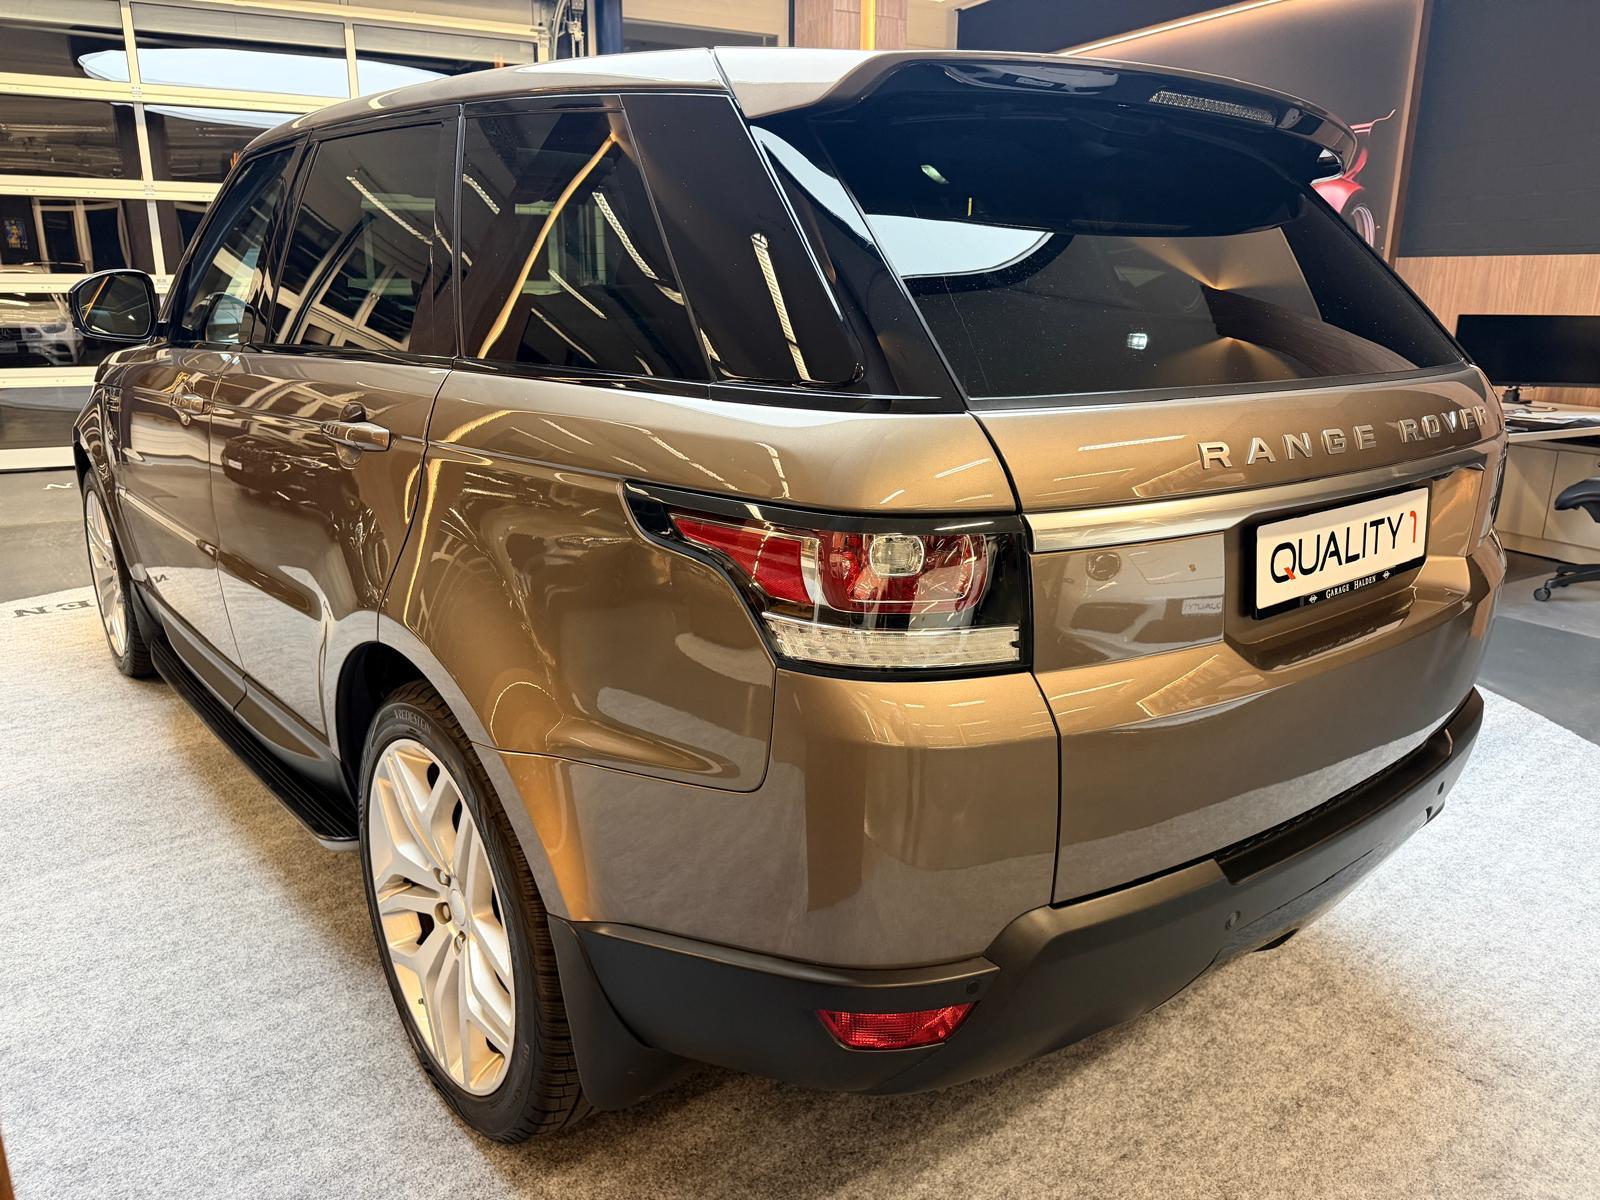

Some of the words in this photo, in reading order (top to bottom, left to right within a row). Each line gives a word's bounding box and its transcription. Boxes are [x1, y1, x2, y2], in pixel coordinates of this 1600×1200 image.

[1197, 424, 1377, 469] RANGE
[1398, 406, 1487, 443] ROVER
[1325, 583, 1350, 599] GARAGE
[1353, 575, 1377, 590] HALDEN
